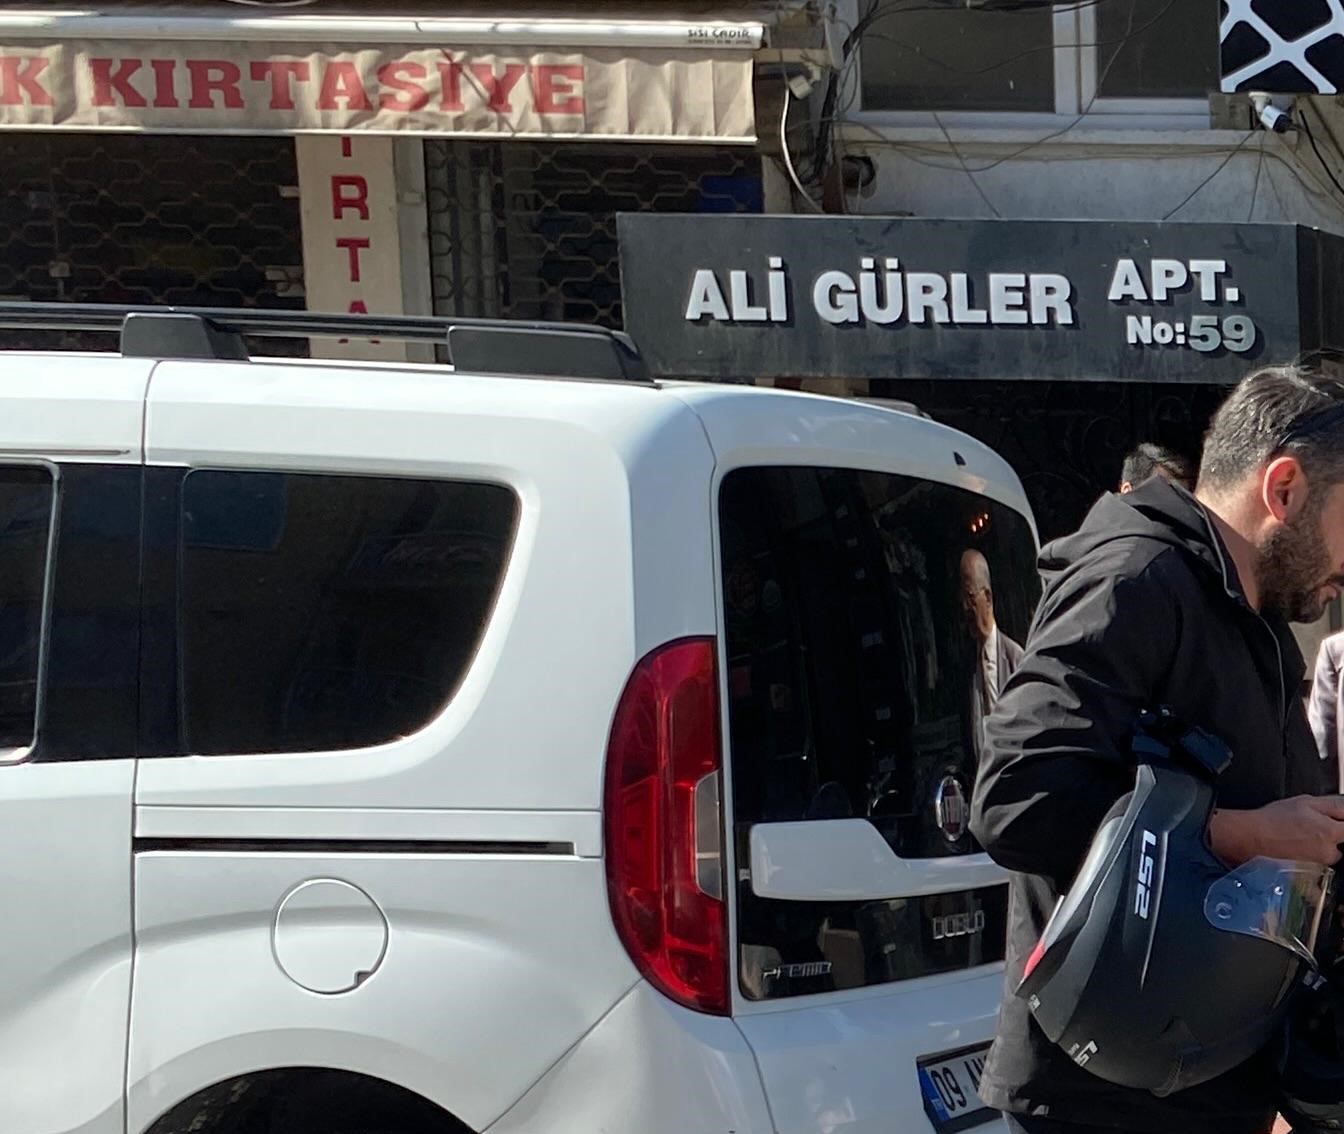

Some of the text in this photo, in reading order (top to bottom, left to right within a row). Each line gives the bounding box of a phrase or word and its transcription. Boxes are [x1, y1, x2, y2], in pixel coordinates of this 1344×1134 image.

[685, 257, 1240, 326] ALİ GÜRLER APT.
[1127, 315, 1256, 352] No:59
[1134, 829, 1157, 920] LS2
[930, 1067, 967, 1111] 09
